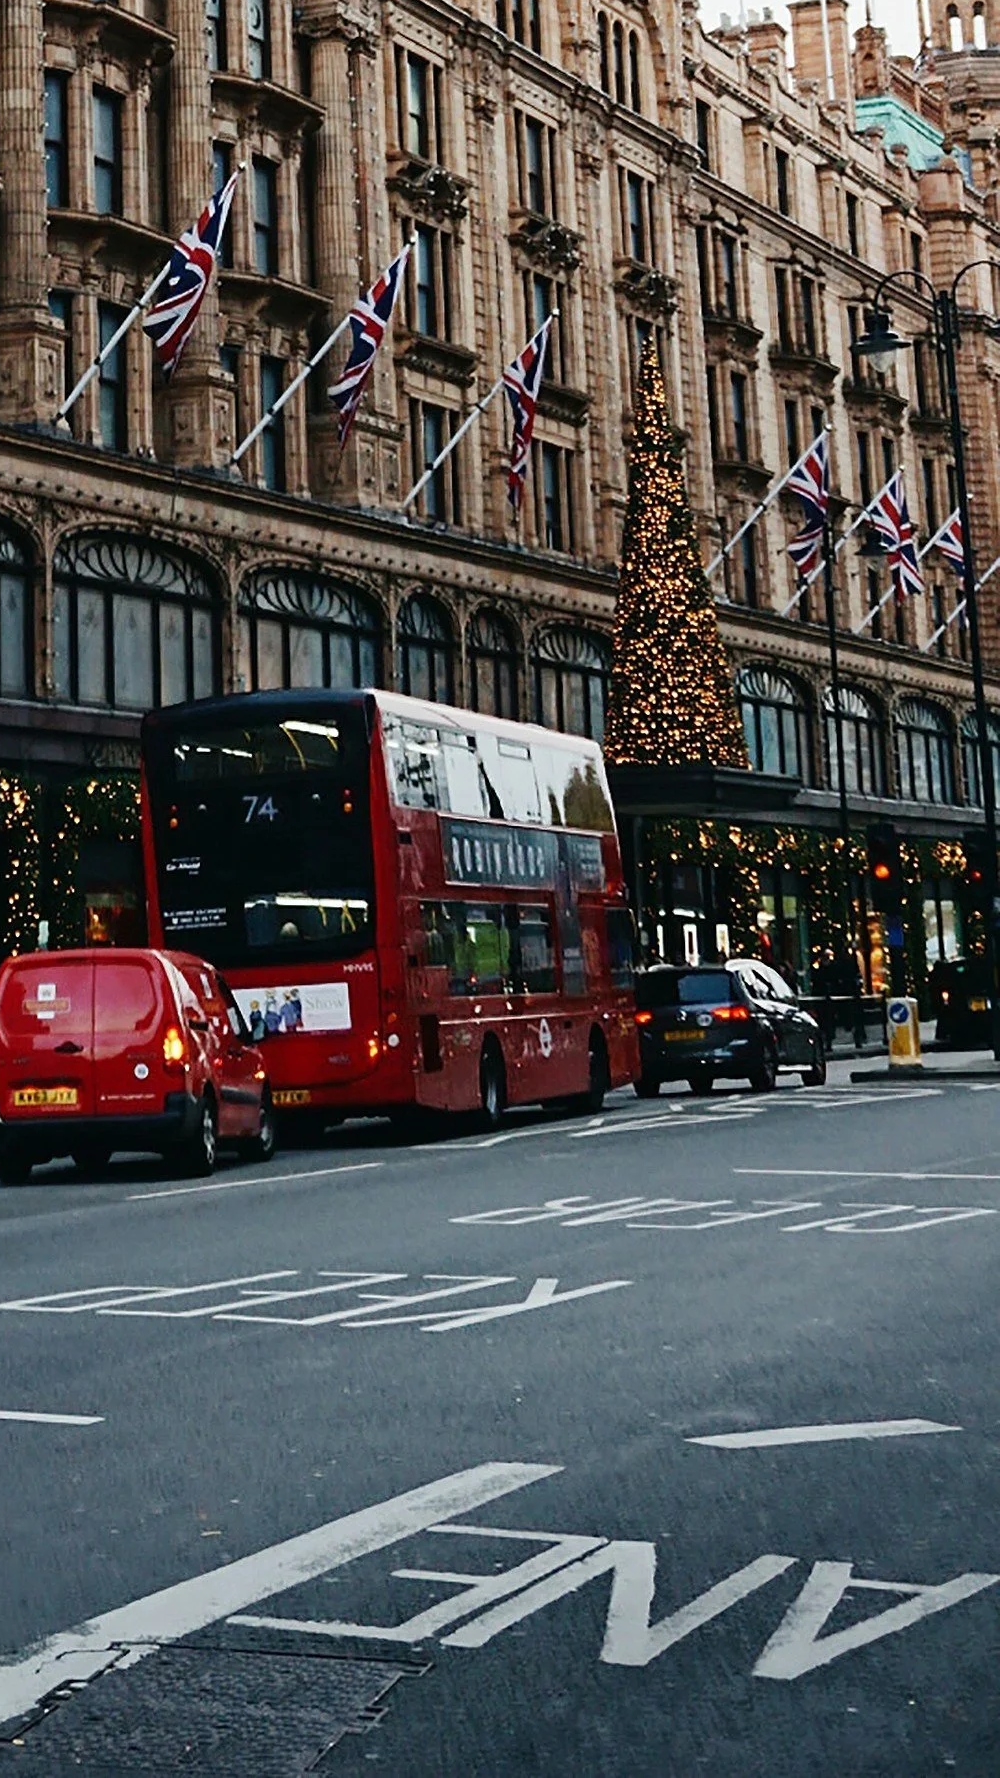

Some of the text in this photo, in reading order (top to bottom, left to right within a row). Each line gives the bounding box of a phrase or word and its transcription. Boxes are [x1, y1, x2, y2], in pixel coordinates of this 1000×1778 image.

[242, 795, 279, 823] 74
[448, 1195, 999, 1233] CLEAR
[226, 1524, 1000, 1681] ANE
